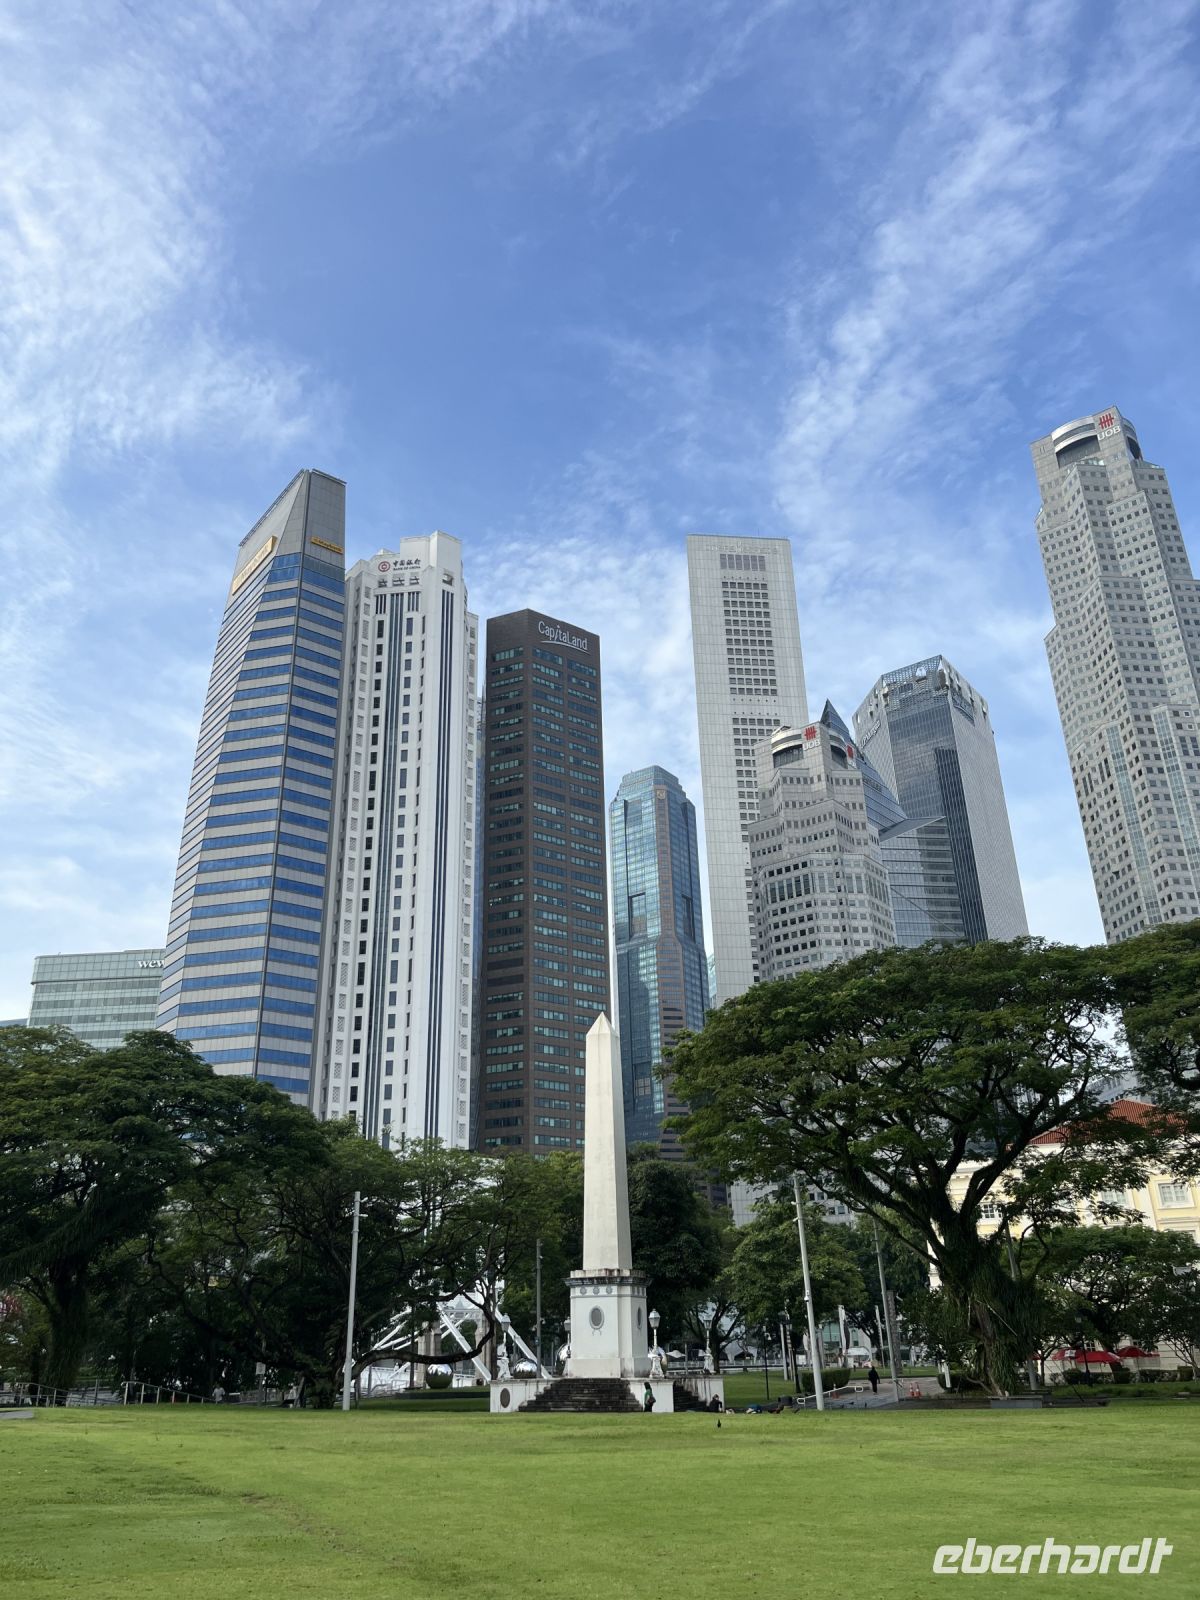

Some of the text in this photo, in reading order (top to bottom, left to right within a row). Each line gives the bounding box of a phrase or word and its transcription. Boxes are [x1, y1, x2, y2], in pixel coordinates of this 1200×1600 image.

[1097, 426, 1120, 441] UOB
[538, 620, 588, 650] CapitaLand
[802, 739, 820, 751] UOB
